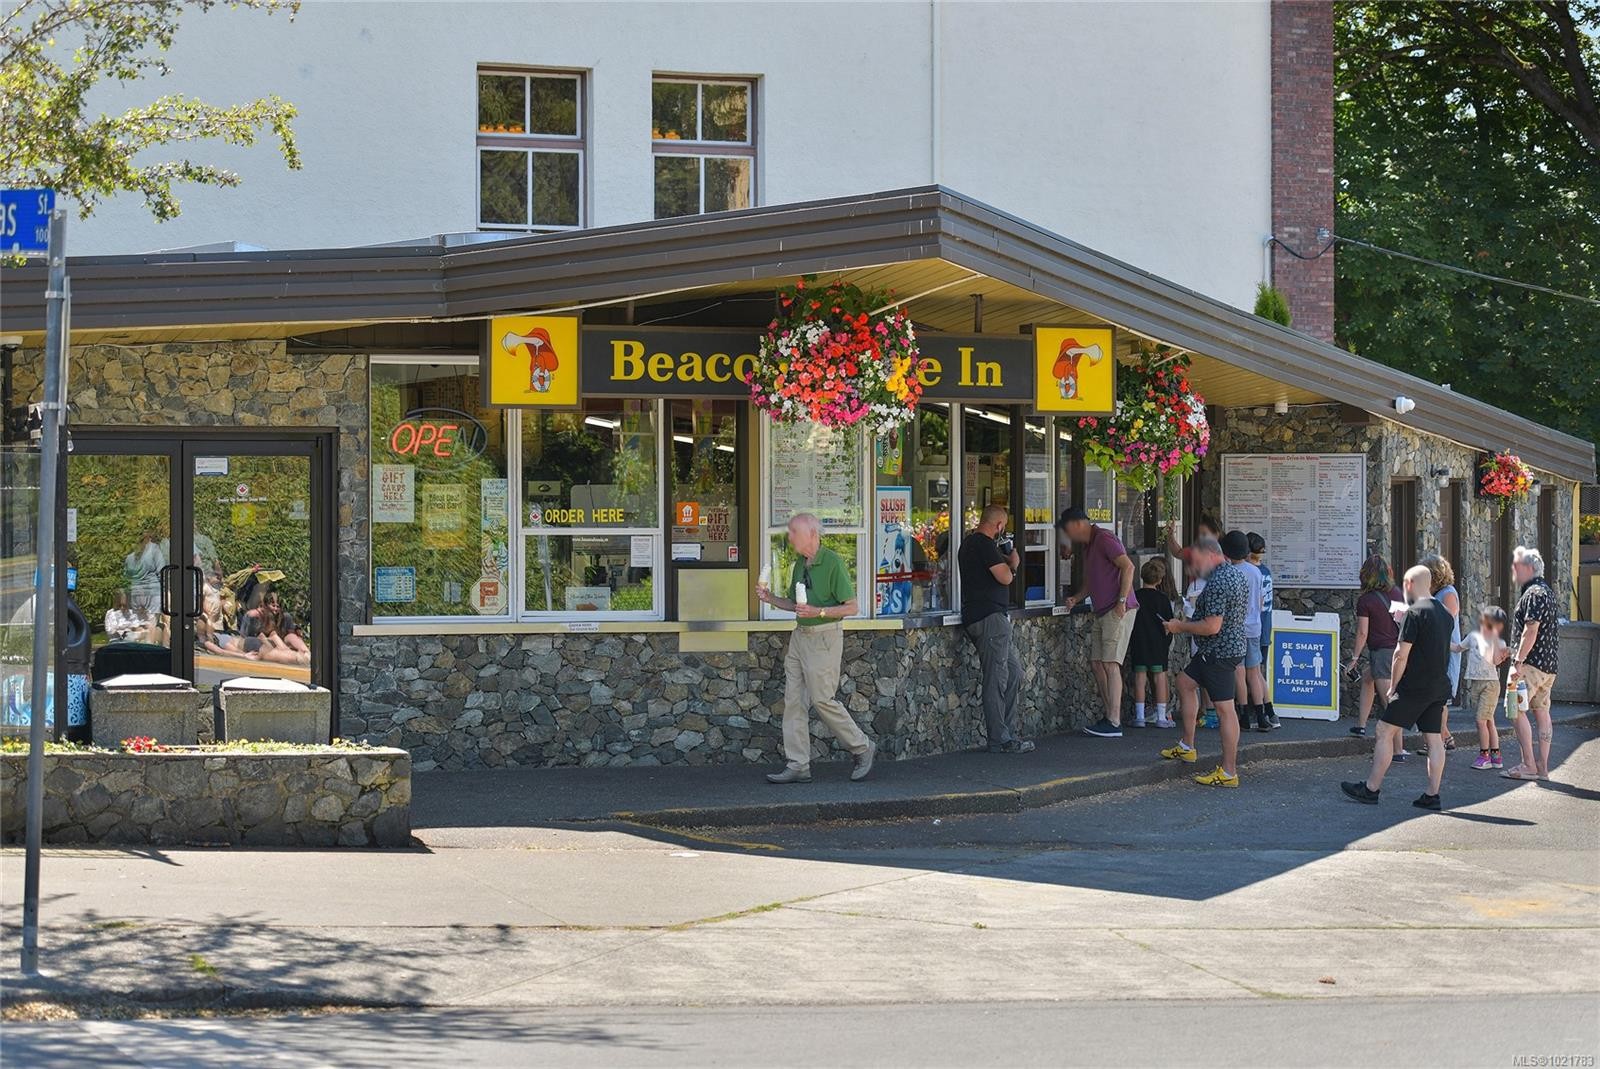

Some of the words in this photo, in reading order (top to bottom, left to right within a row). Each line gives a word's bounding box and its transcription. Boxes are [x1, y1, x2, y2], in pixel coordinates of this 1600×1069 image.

[36, 228, 49, 243] 100
[610, 340, 758, 382] Beaco
[958, 347, 1004, 387] In
[382, 472, 406, 483] GIFT
[880, 498, 906, 511] SLUSH
[545, 509, 585, 523] ORDER
[592, 508, 625, 522] HERE
[707, 513, 729, 524] GIFT
[708, 532, 728, 541] HERE
[1282, 642, 1293, 650] BE
[1295, 643, 1325, 651] SMART
[1306, 679, 1328, 687] STAND
